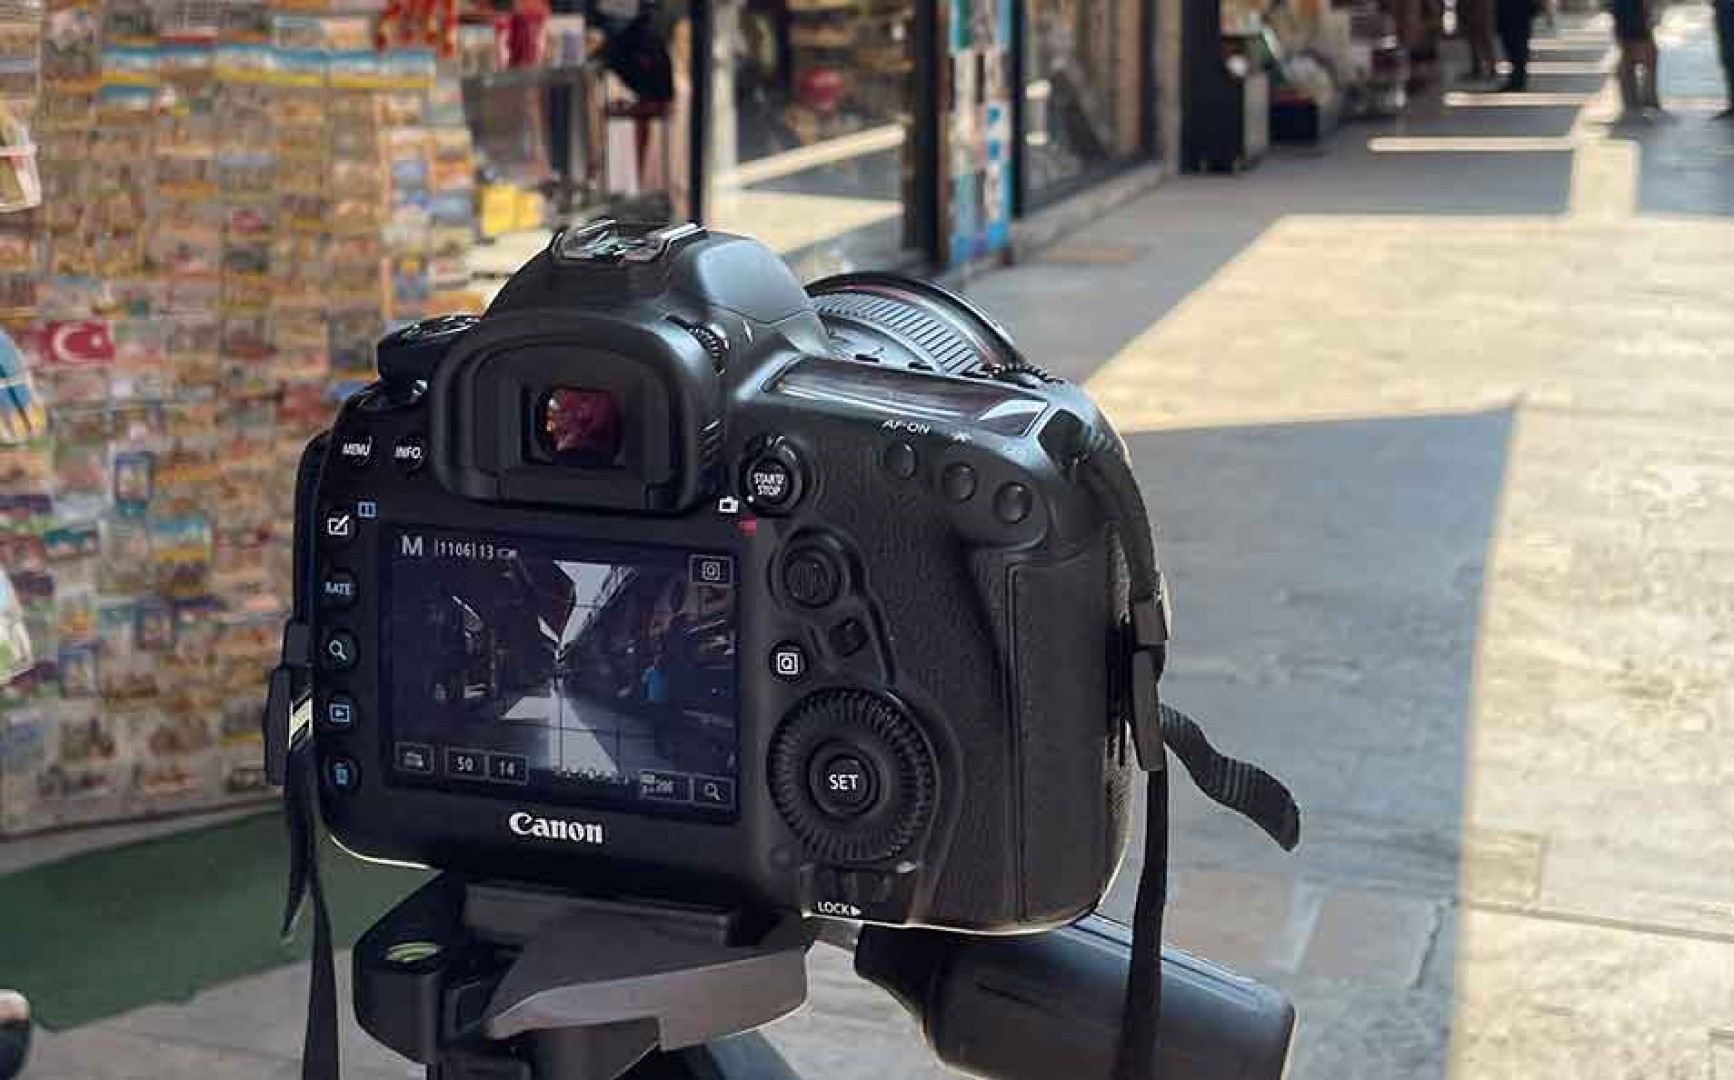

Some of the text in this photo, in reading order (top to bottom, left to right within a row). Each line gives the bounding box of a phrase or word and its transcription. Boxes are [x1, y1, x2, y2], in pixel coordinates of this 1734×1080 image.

[882, 419, 931, 434] AF-ON
[342, 441, 371, 457] MENU
[758, 485, 781, 496] STOP
[401, 535, 422, 557] M
[829, 774, 858, 790] SET
[509, 812, 602, 844] Canon
[817, 901, 850, 915] LOCK
